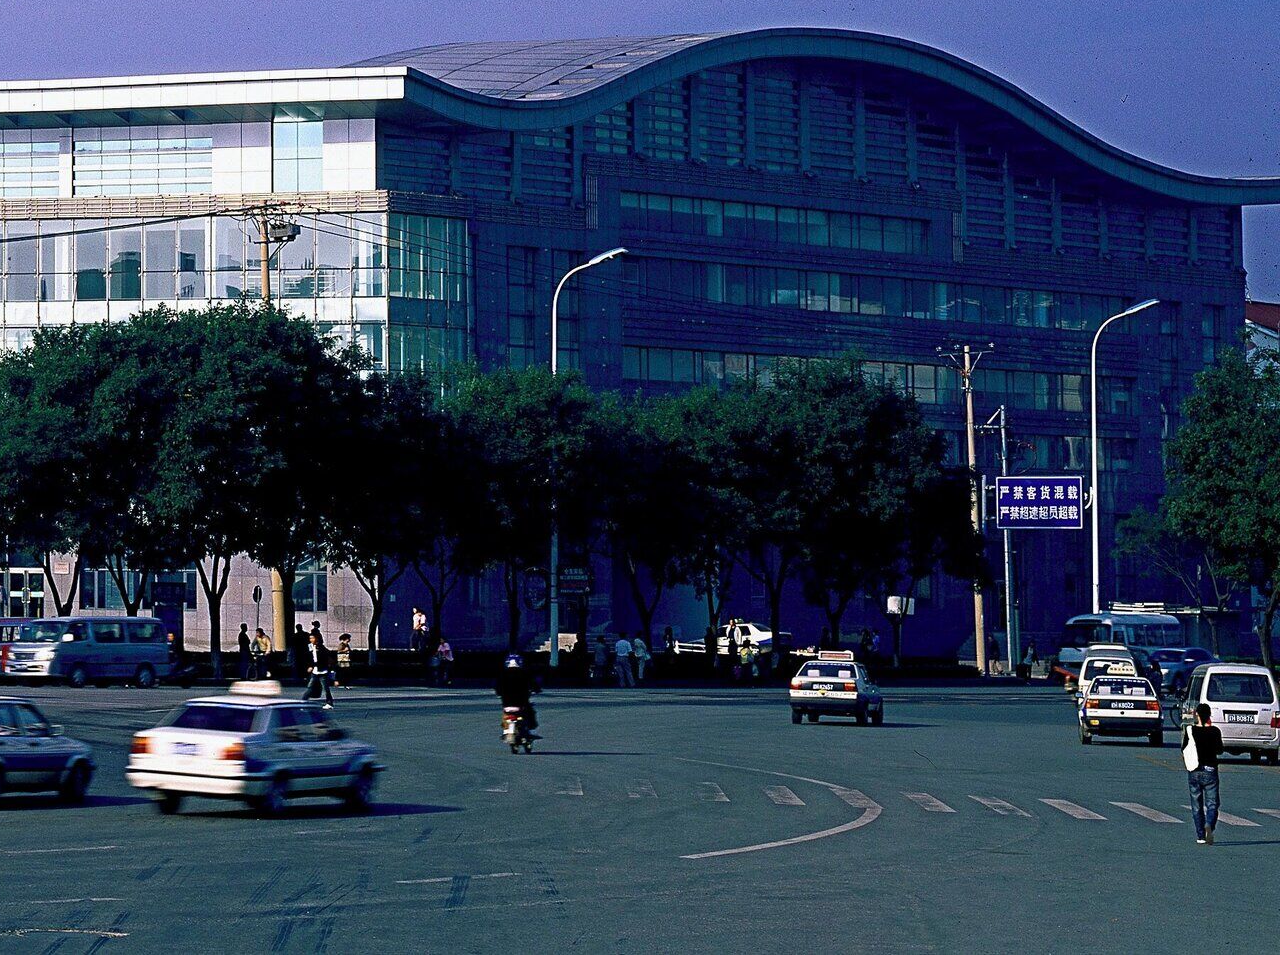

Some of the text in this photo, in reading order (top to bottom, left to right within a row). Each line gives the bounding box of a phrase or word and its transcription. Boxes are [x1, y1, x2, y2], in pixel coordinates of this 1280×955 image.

[1000, 485, 1079, 500] 严禁客货混载
[1000, 506, 1079, 520] 严禁超速超员超载
